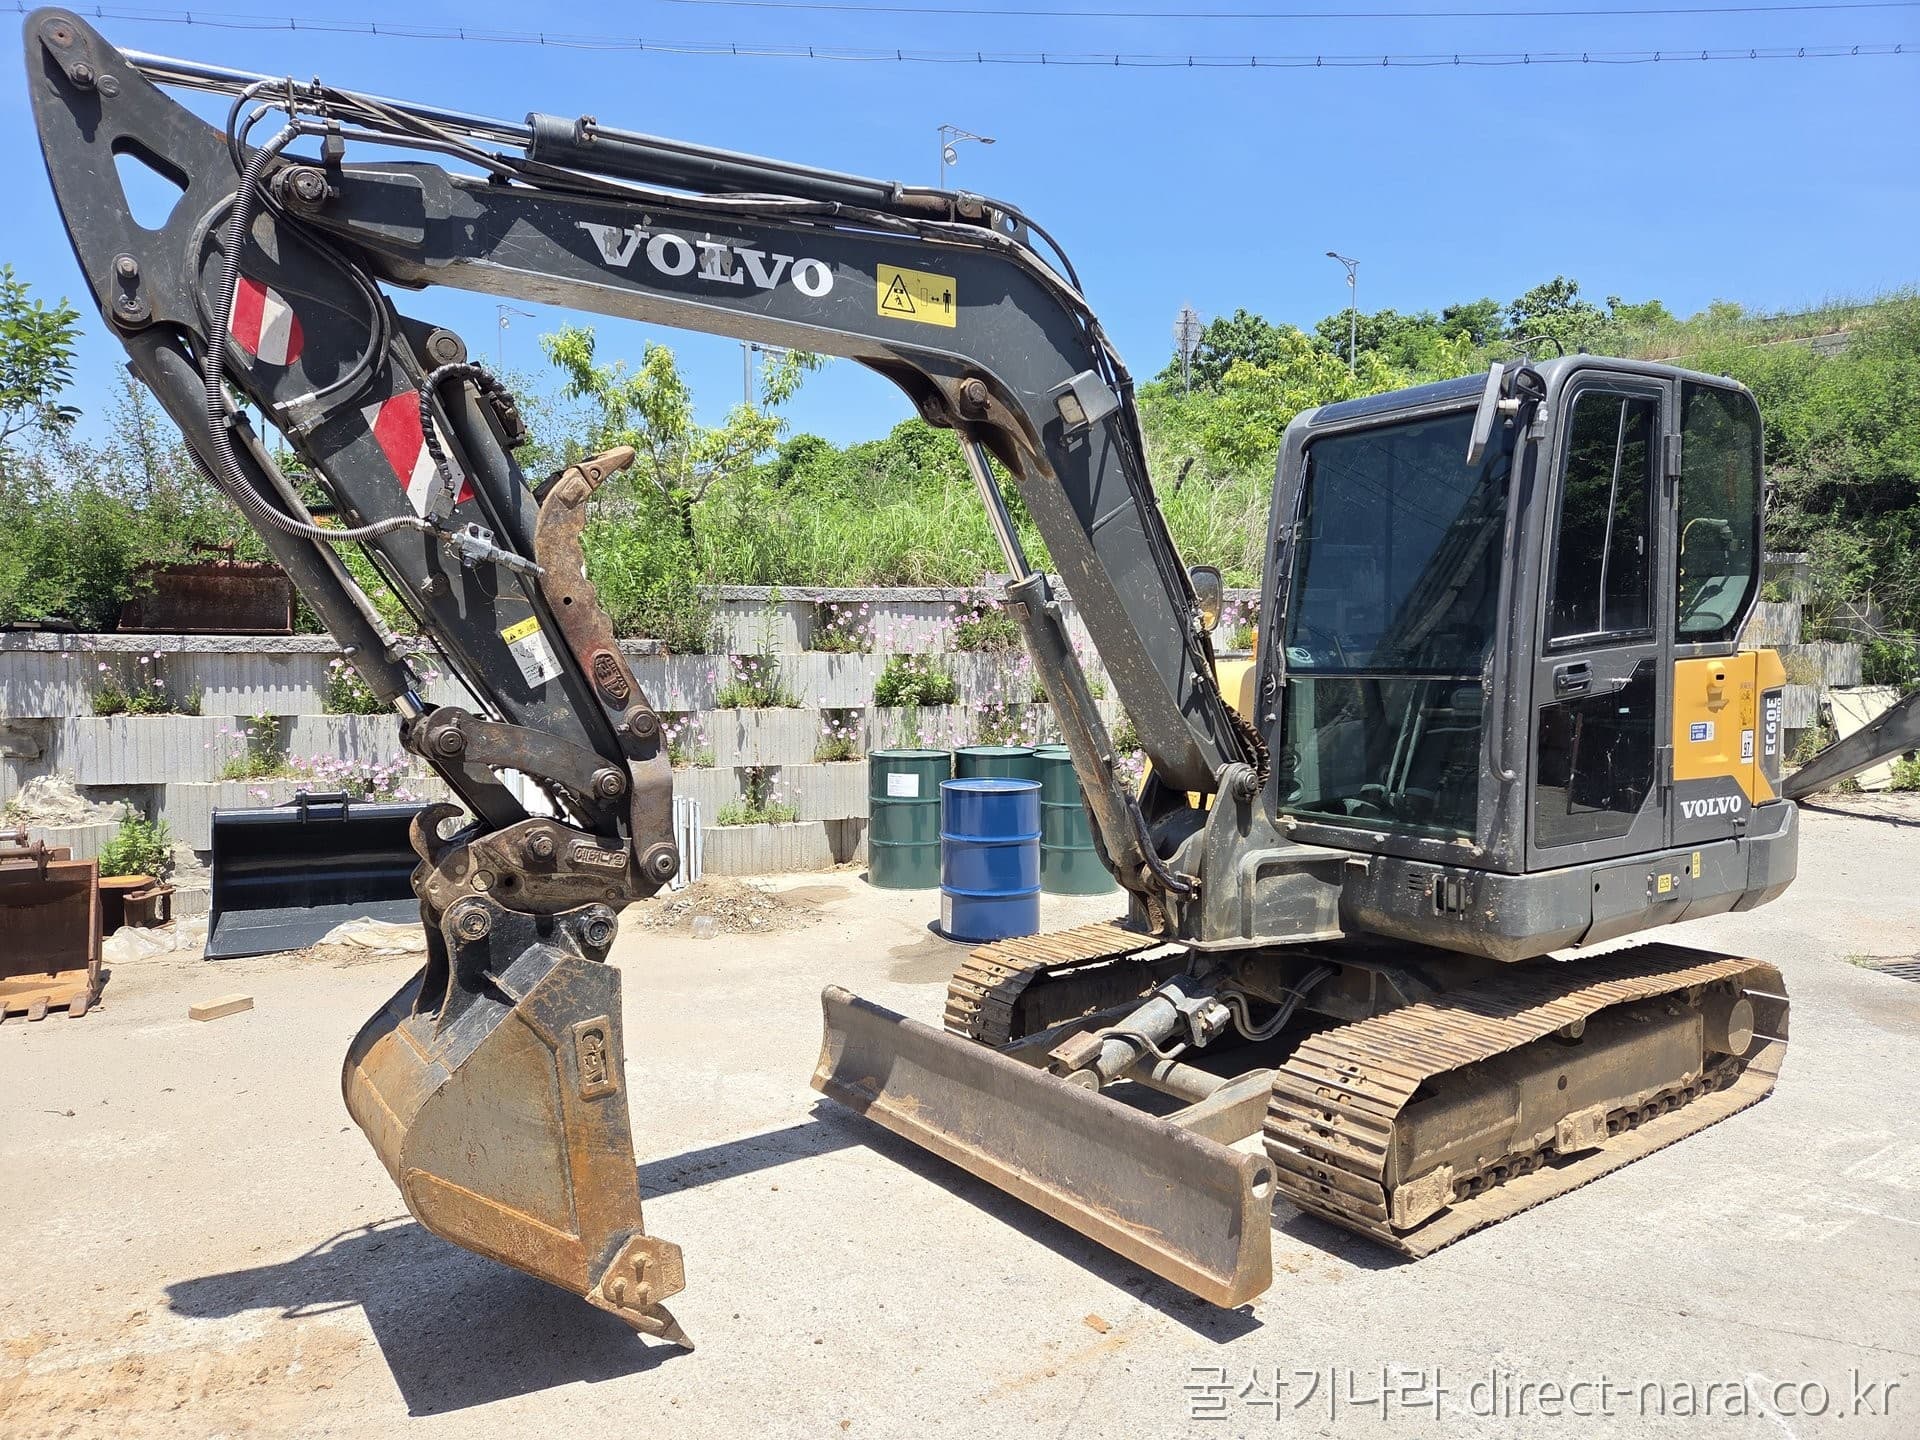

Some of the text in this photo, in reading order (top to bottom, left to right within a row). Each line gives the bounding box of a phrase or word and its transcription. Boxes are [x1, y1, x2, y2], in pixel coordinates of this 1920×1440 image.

[579, 220, 834, 298] VOLVO
[1765, 697, 1777, 755] EC60E
[1680, 795, 1742, 819] VOLVO
